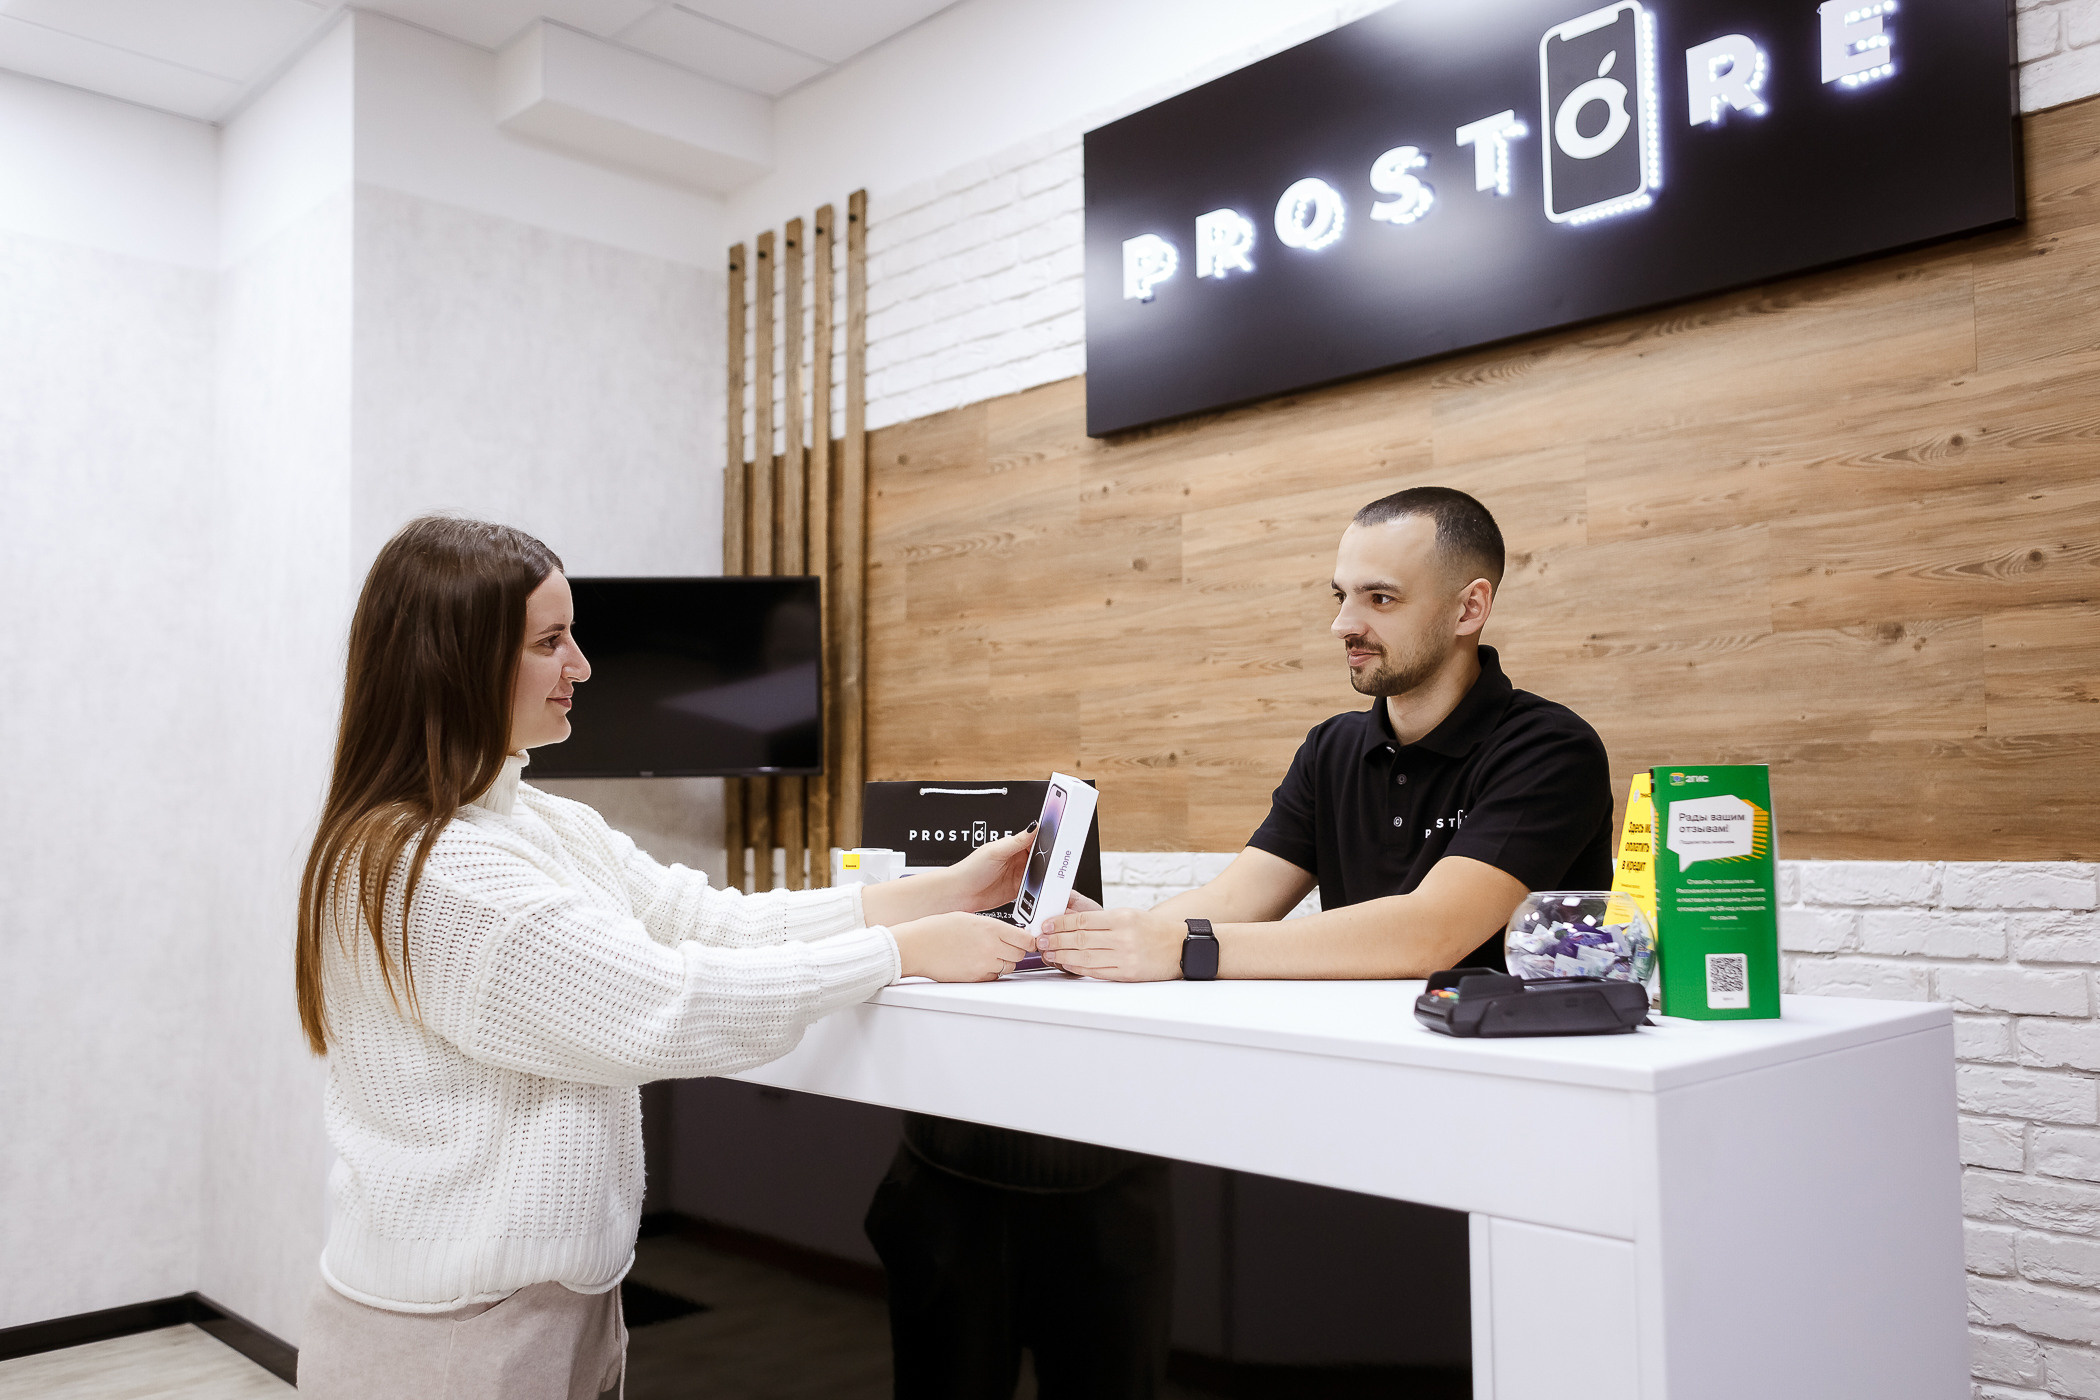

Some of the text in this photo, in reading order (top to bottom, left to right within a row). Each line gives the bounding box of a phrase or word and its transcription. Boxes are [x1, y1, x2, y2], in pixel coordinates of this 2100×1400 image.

[1122, 0, 1896, 303] PROSTORE
[1679, 813, 1708, 822] Рады
[1679, 824, 1729, 833] отзывам!
[1057, 850, 1071, 879] iPhone
